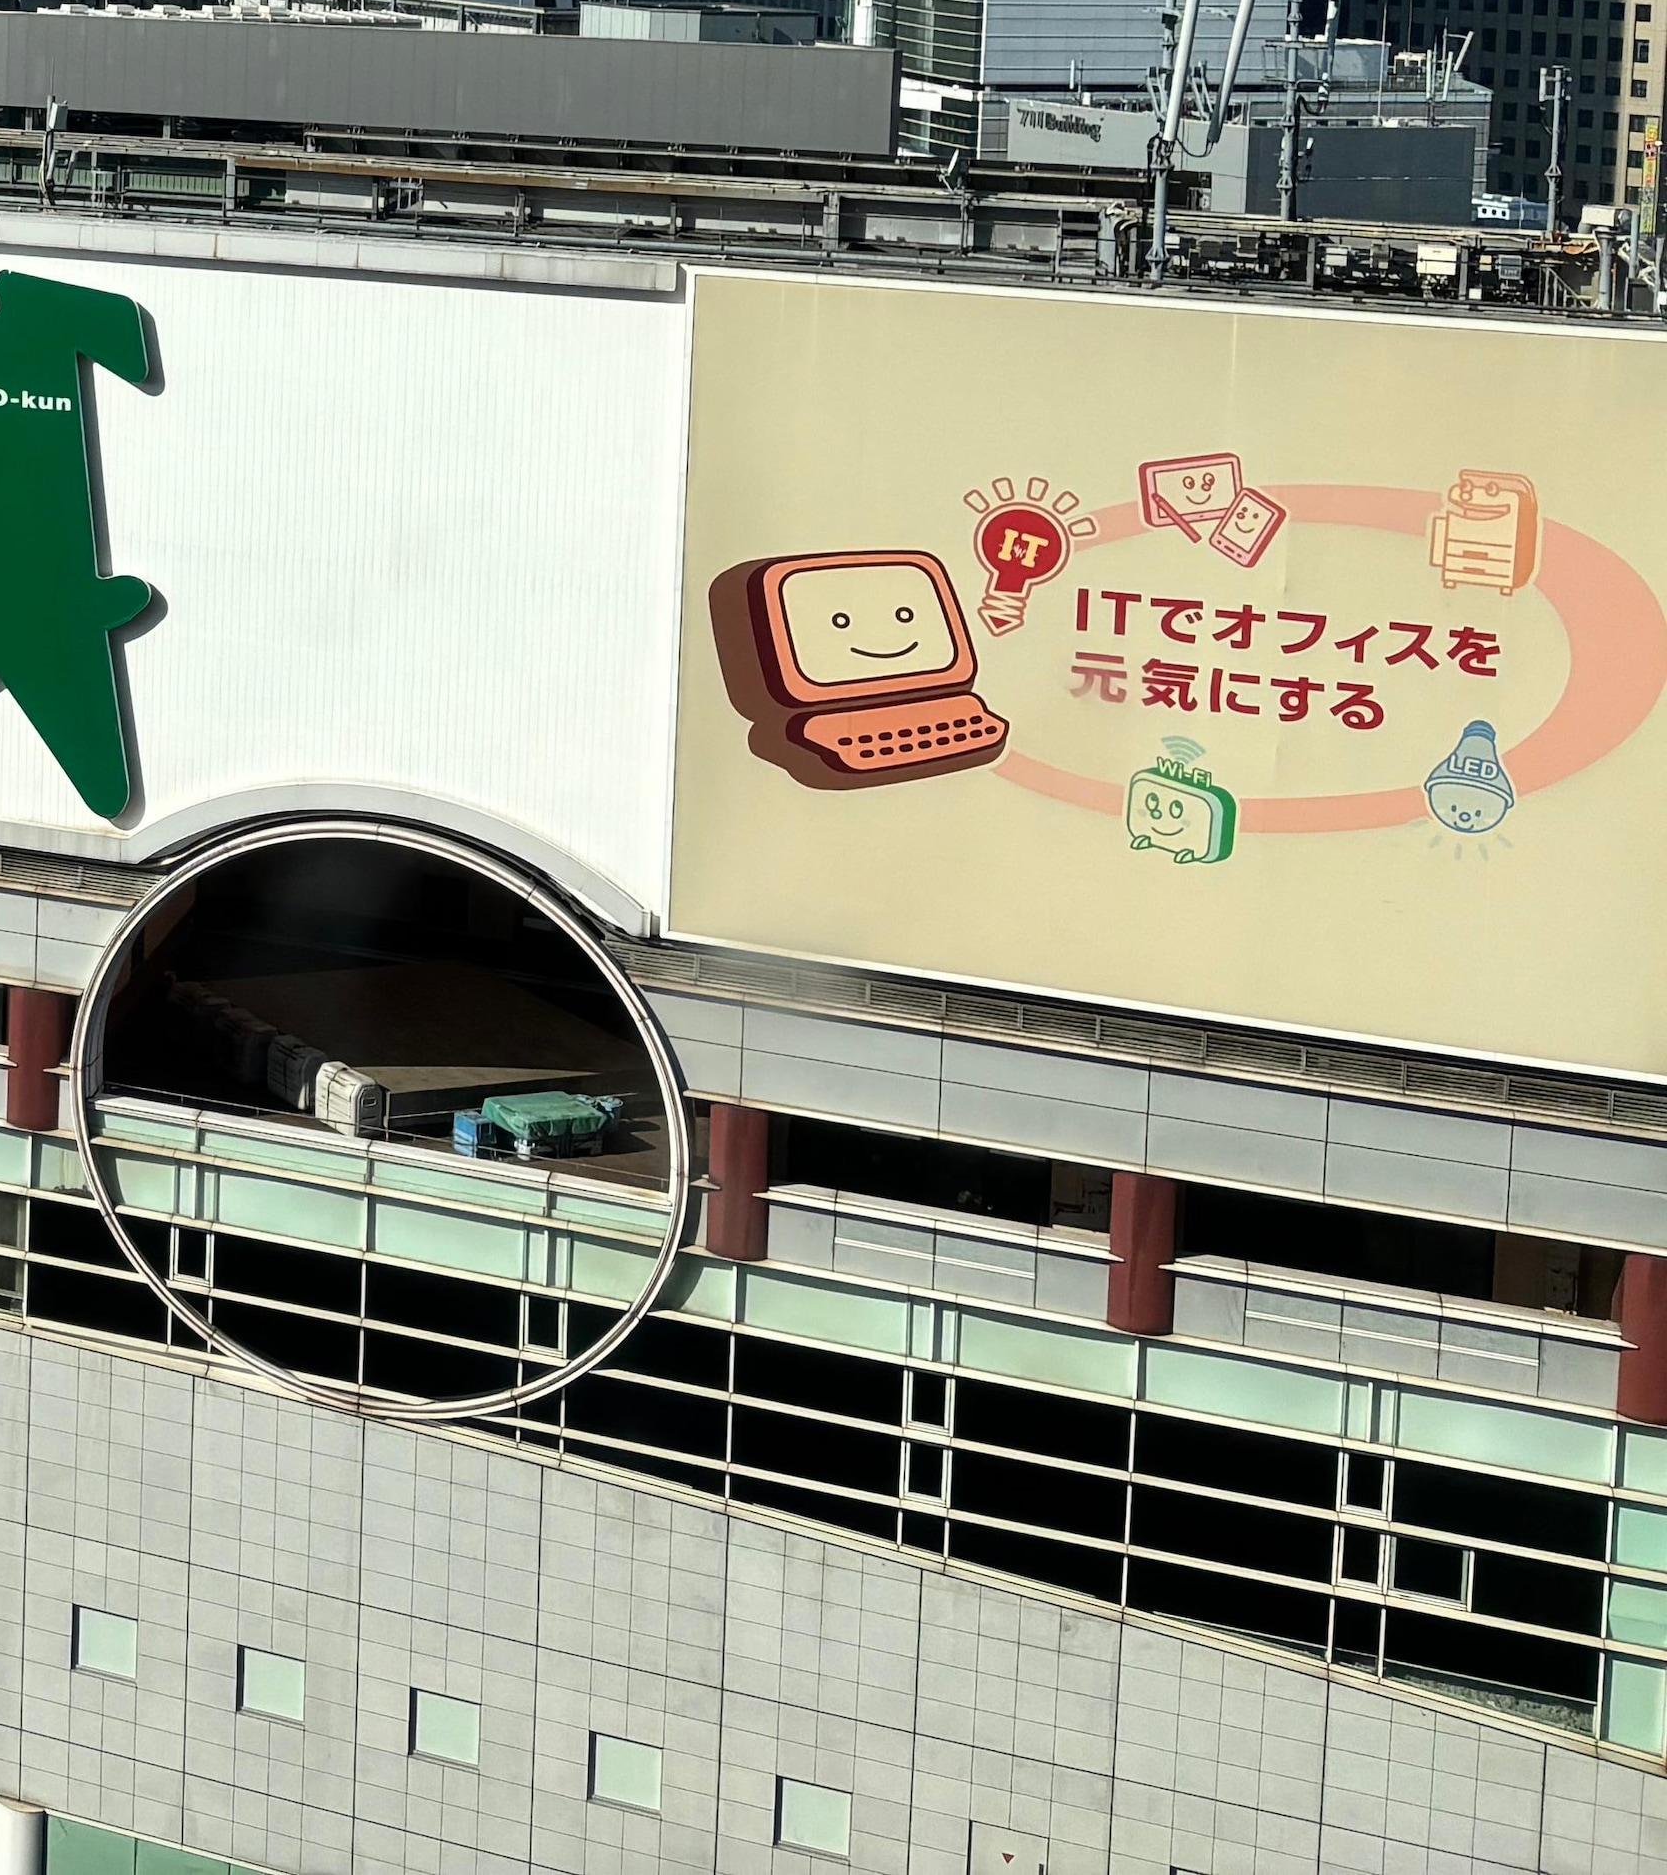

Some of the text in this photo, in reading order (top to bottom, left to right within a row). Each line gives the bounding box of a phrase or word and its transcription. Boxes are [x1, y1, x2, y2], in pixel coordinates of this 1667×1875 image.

[1045, 112, 1102, 143] Building
[999, 527, 1048, 569] IT
[1075, 588, 1503, 679] ITでオフィスを
[1069, 652, 1385, 732] 元気にする
[1156, 754, 1212, 790] Wi-Fi
[1448, 753, 1498, 781] LED
